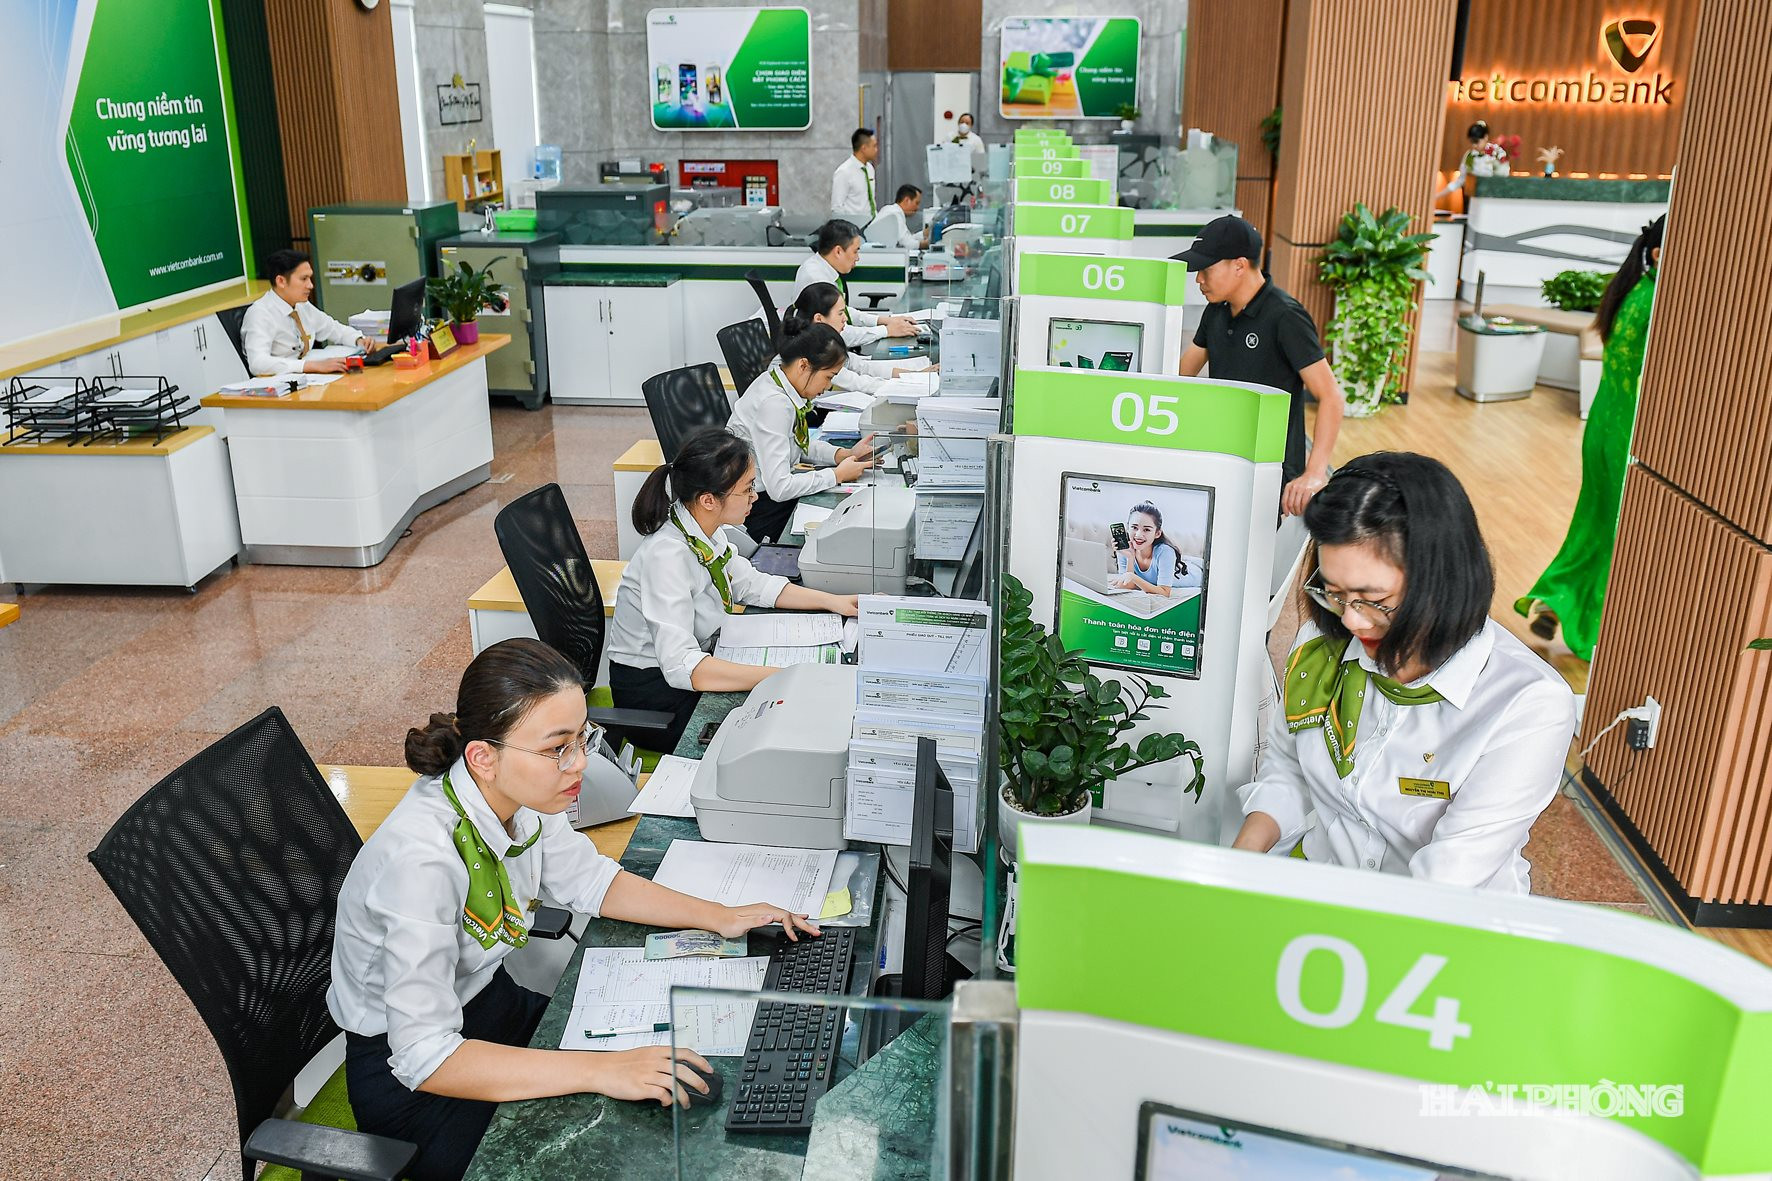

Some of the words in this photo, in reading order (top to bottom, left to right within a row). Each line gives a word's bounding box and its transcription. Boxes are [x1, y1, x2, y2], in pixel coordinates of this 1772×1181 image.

[96, 98, 146, 121] Chung
[148, 92, 183, 116] niềm
[184, 94, 204, 114] tin
[107, 130, 146, 153] vững
[148, 130, 190, 149] tương
[191, 124, 208, 143] lai
[1042, 148, 1056, 160] 10
[1042, 162, 1062, 175] 09
[1050, 184, 1075, 200] 08
[1061, 214, 1092, 234] 07
[149, 252, 224, 277] www.vietcombank.com.vn
[1082, 264, 1125, 291] 06
[1111, 392, 1179, 436] 05
[1082, 618, 1106, 626] Thanh
[1276, 933, 1472, 1052] 04
[1168, 1124, 1242, 1149] Vietcombank
